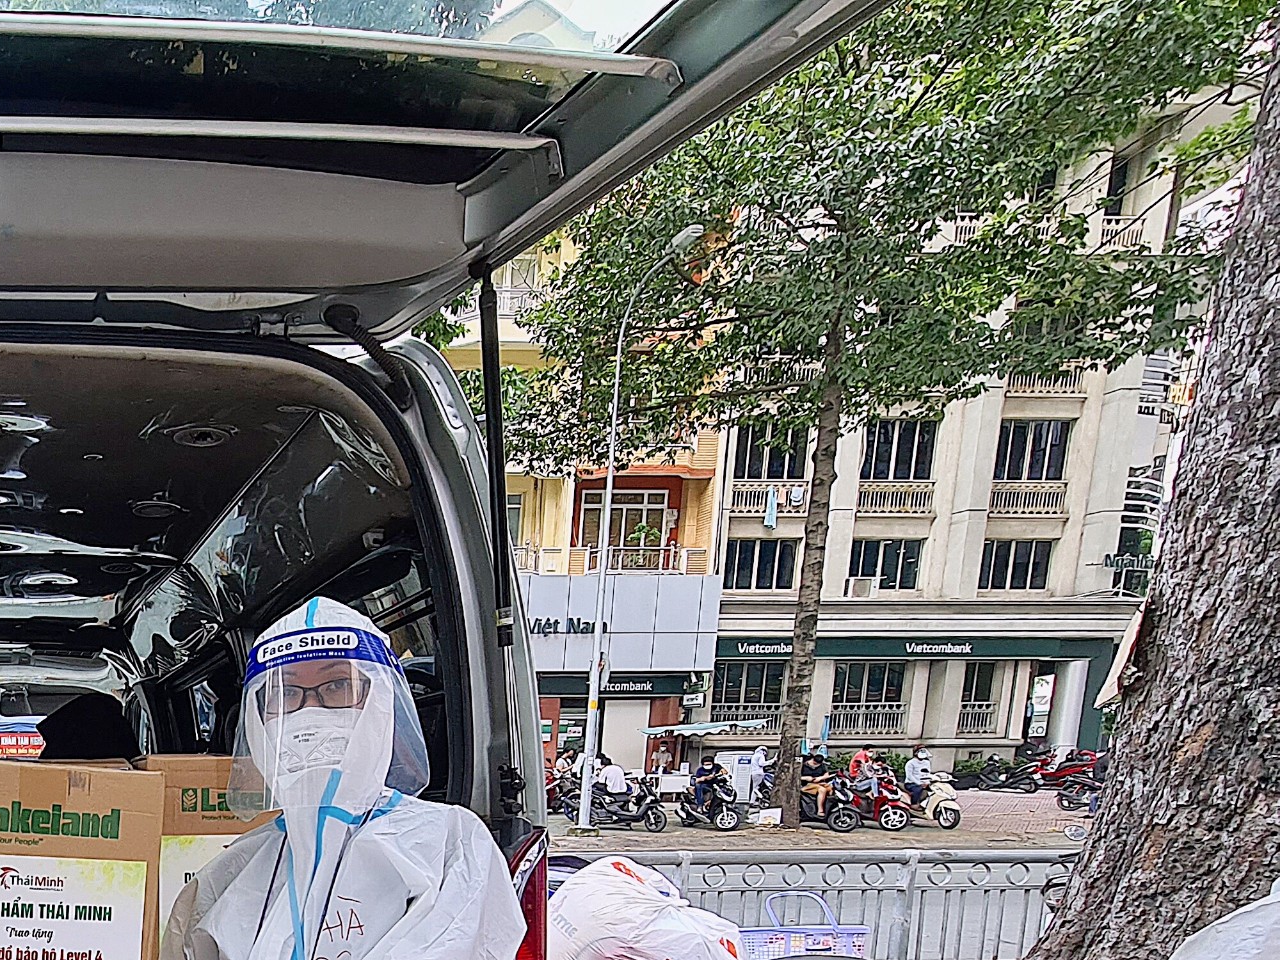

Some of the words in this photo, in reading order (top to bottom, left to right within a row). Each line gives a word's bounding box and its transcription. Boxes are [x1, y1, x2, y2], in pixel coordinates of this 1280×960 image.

[527, 617, 560, 637] Việt
[262, 642, 293, 659] Face
[299, 635, 351, 648] Shield
[738, 643, 793, 654] Vietcomba
[905, 643, 972, 654] Vietcombank
[600, 681, 653, 692] etcombank
[38, 901, 70, 920] THÁI
[74, 905, 113, 922] MINH
[5, 926, 30, 938] Trao
[31, 928, 54, 943] tặng
[553, 914, 578, 938] STYLE
